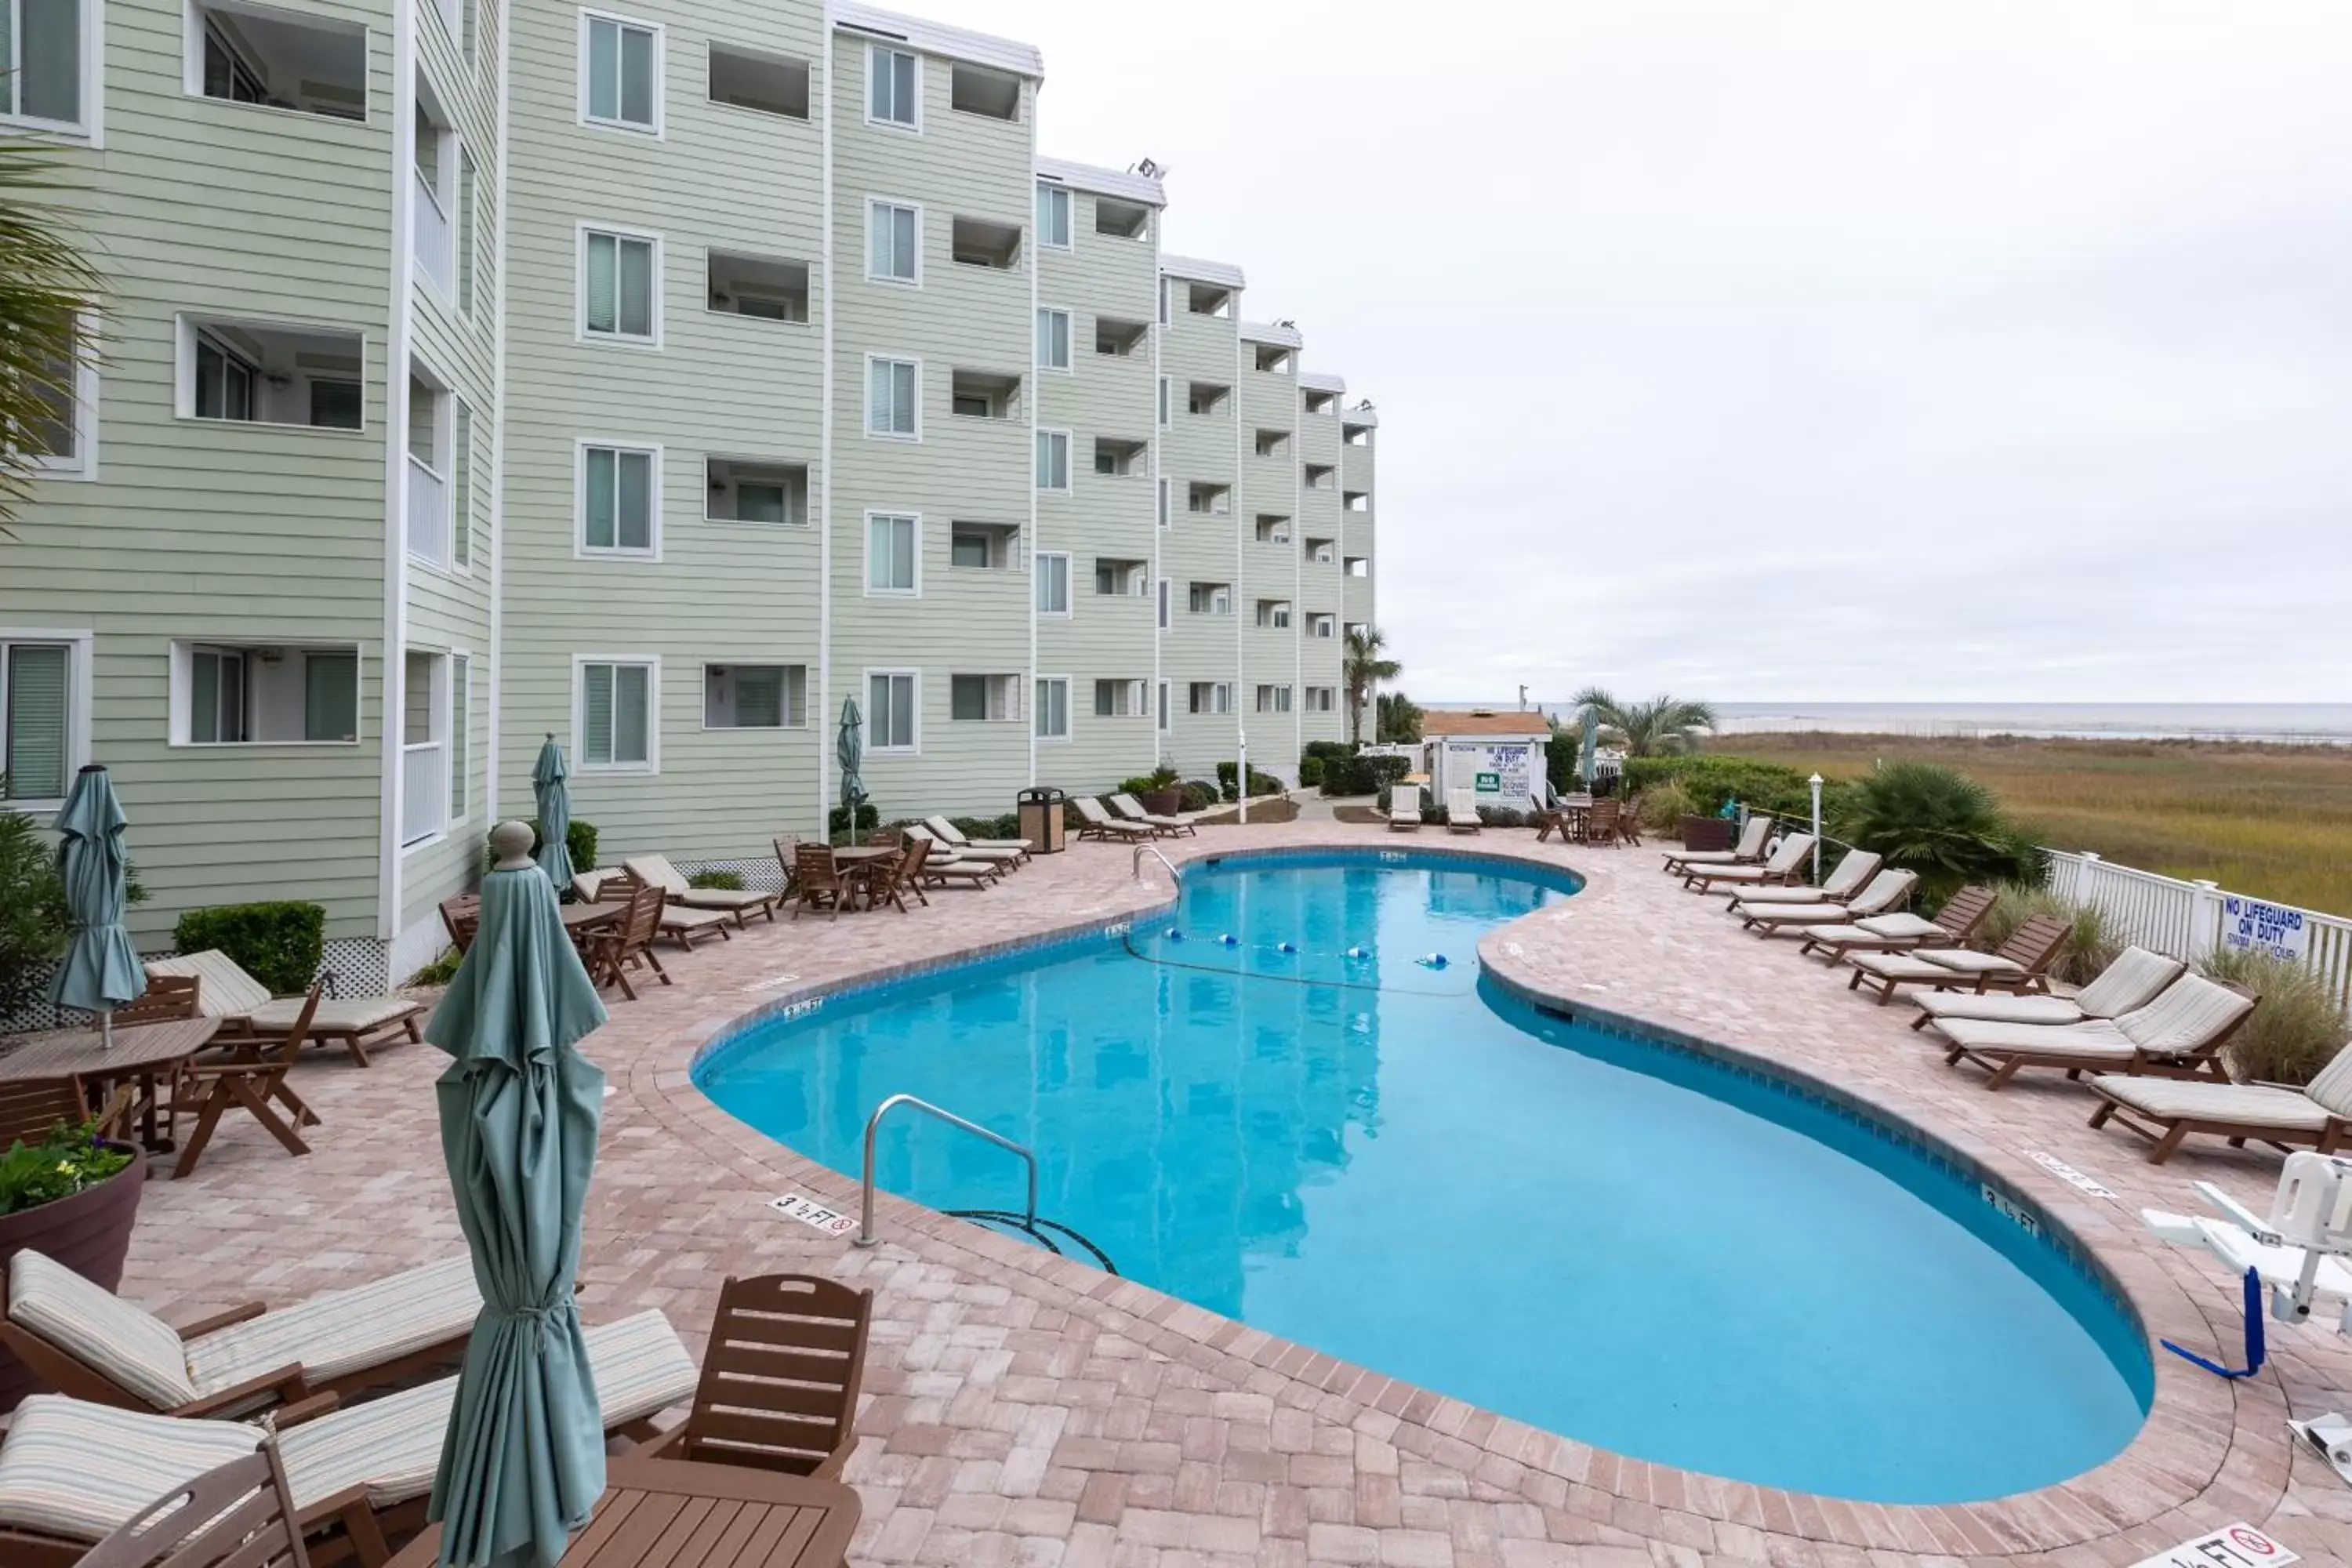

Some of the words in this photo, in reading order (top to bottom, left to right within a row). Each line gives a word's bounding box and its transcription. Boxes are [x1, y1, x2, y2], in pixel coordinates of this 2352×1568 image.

[2226, 897, 2240, 916] NO
[2245, 902, 2303, 931] LIFEGUARD
[2238, 918, 2252, 936] ON
[2257, 924, 2285, 944] DUTY
[777, 1197, 797, 1207] 3
[807, 1210, 837, 1225] FT
[2020, 1213, 2034, 1235] FT
[2196, 1538, 2254, 1568] FT
